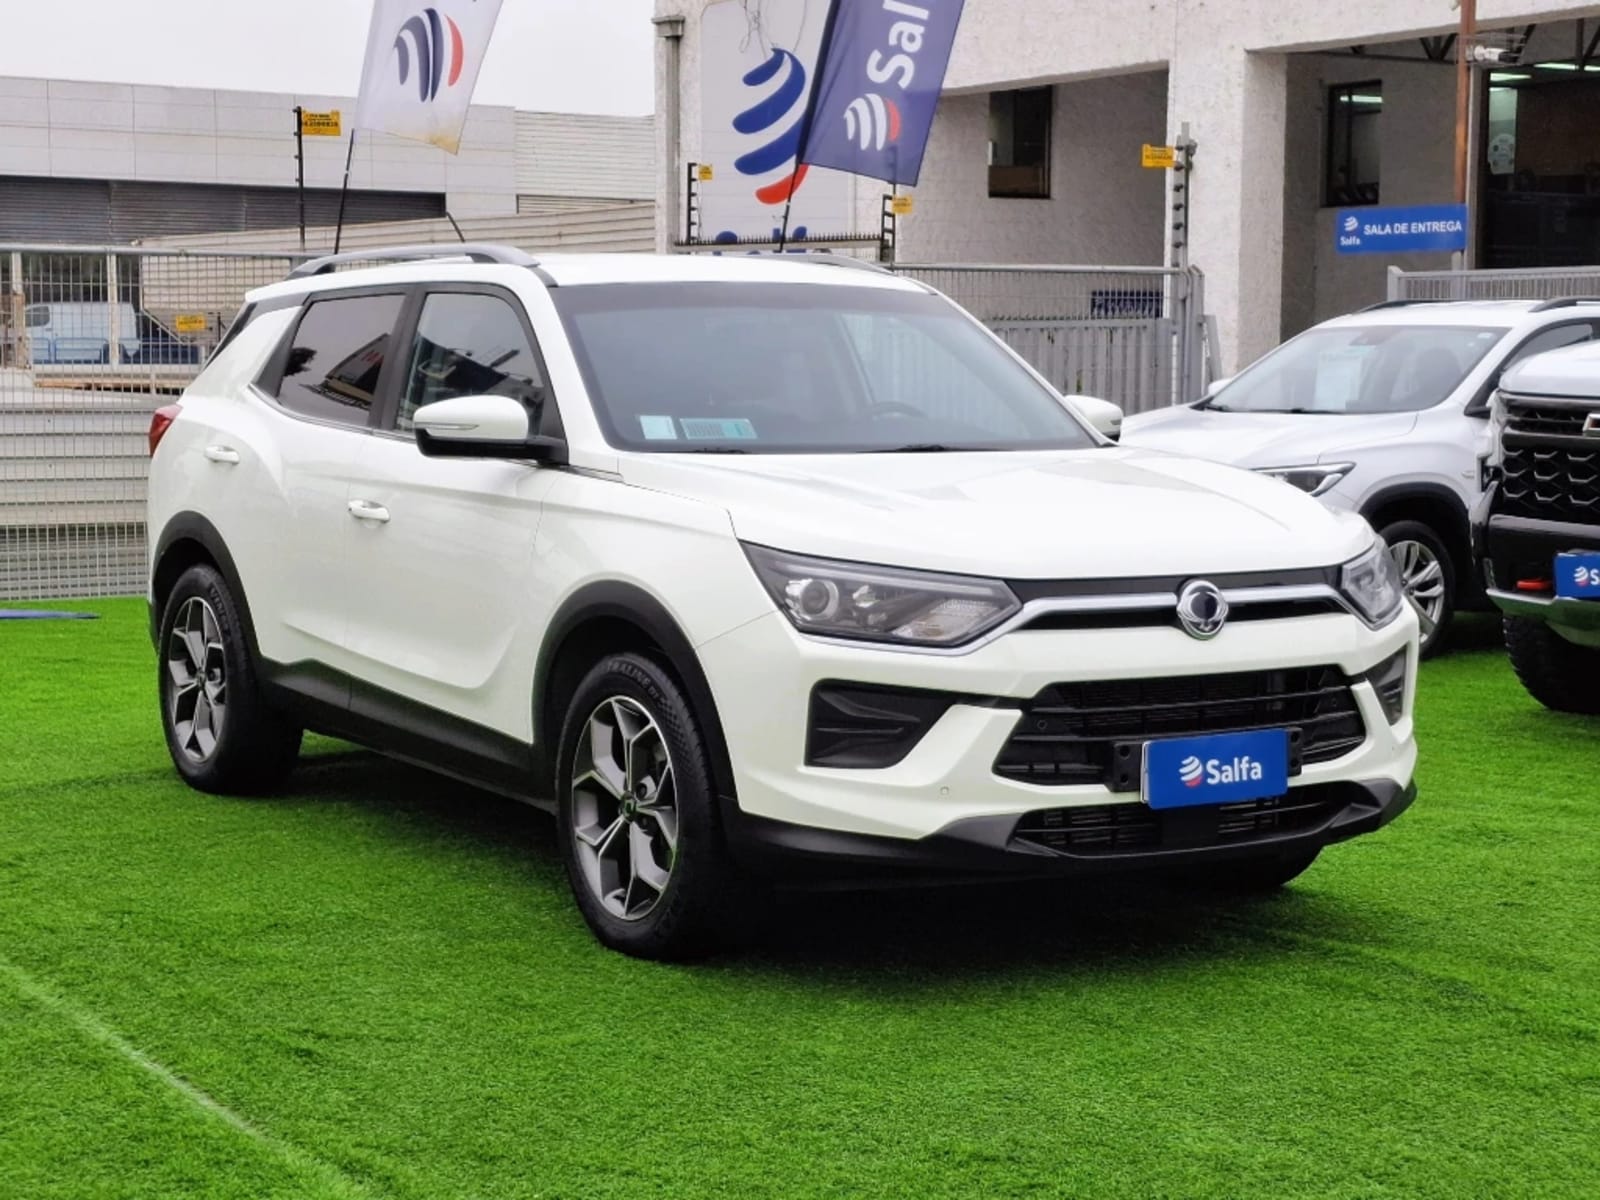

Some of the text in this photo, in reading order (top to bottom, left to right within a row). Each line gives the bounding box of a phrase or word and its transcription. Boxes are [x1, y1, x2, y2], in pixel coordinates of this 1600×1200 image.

[1363, 220, 1462, 236] SALA DE ENTREGA
[1340, 236, 1361, 246] Salfa
[1590, 568, 1600, 585] S
[1206, 755, 1262, 785] Salfa
